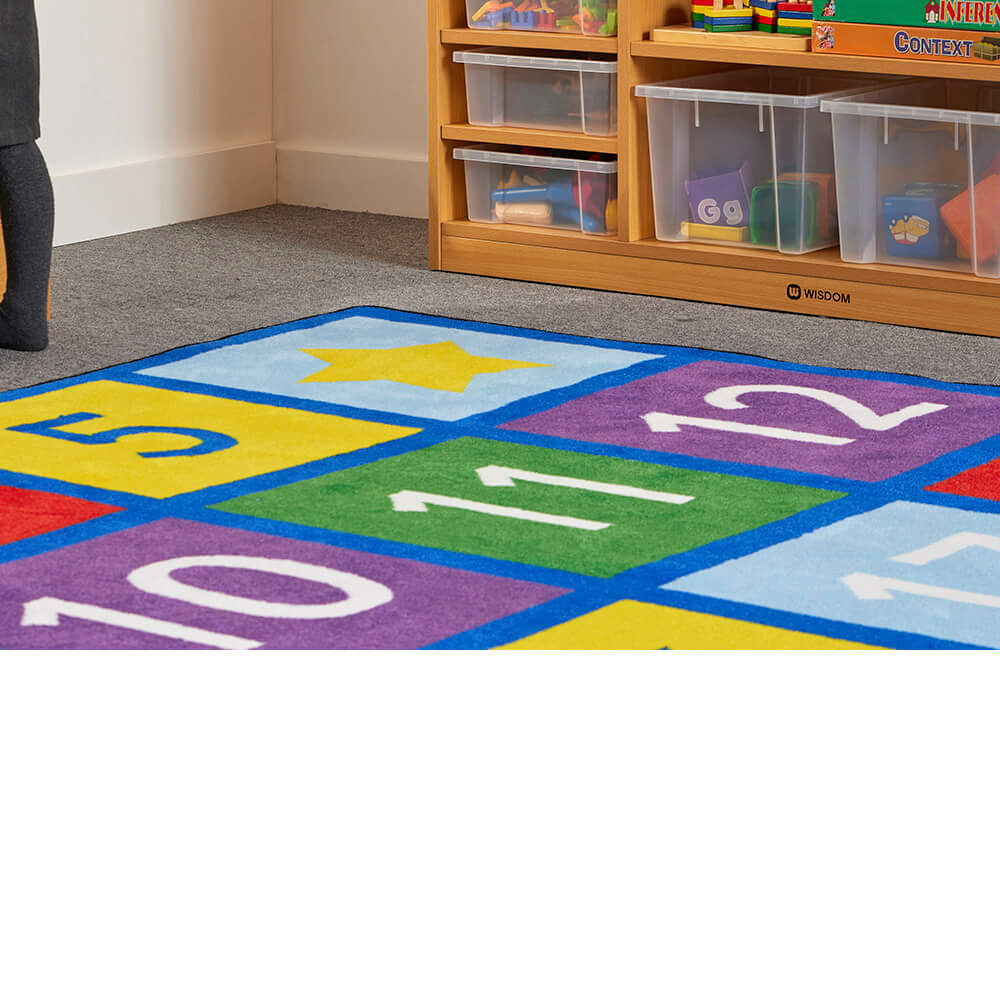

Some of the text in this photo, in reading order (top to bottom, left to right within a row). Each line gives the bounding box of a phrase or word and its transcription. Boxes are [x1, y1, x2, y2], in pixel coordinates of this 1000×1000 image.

[894, 31, 973, 58] CONTEXT
[697, 198, 744, 225] Gg
[804, 288, 850, 304] WISDOM
[4, 411, 239, 459] 5
[641, 383, 949, 446] 12
[389, 464, 696, 531] 11
[20, 554, 394, 650] 10
